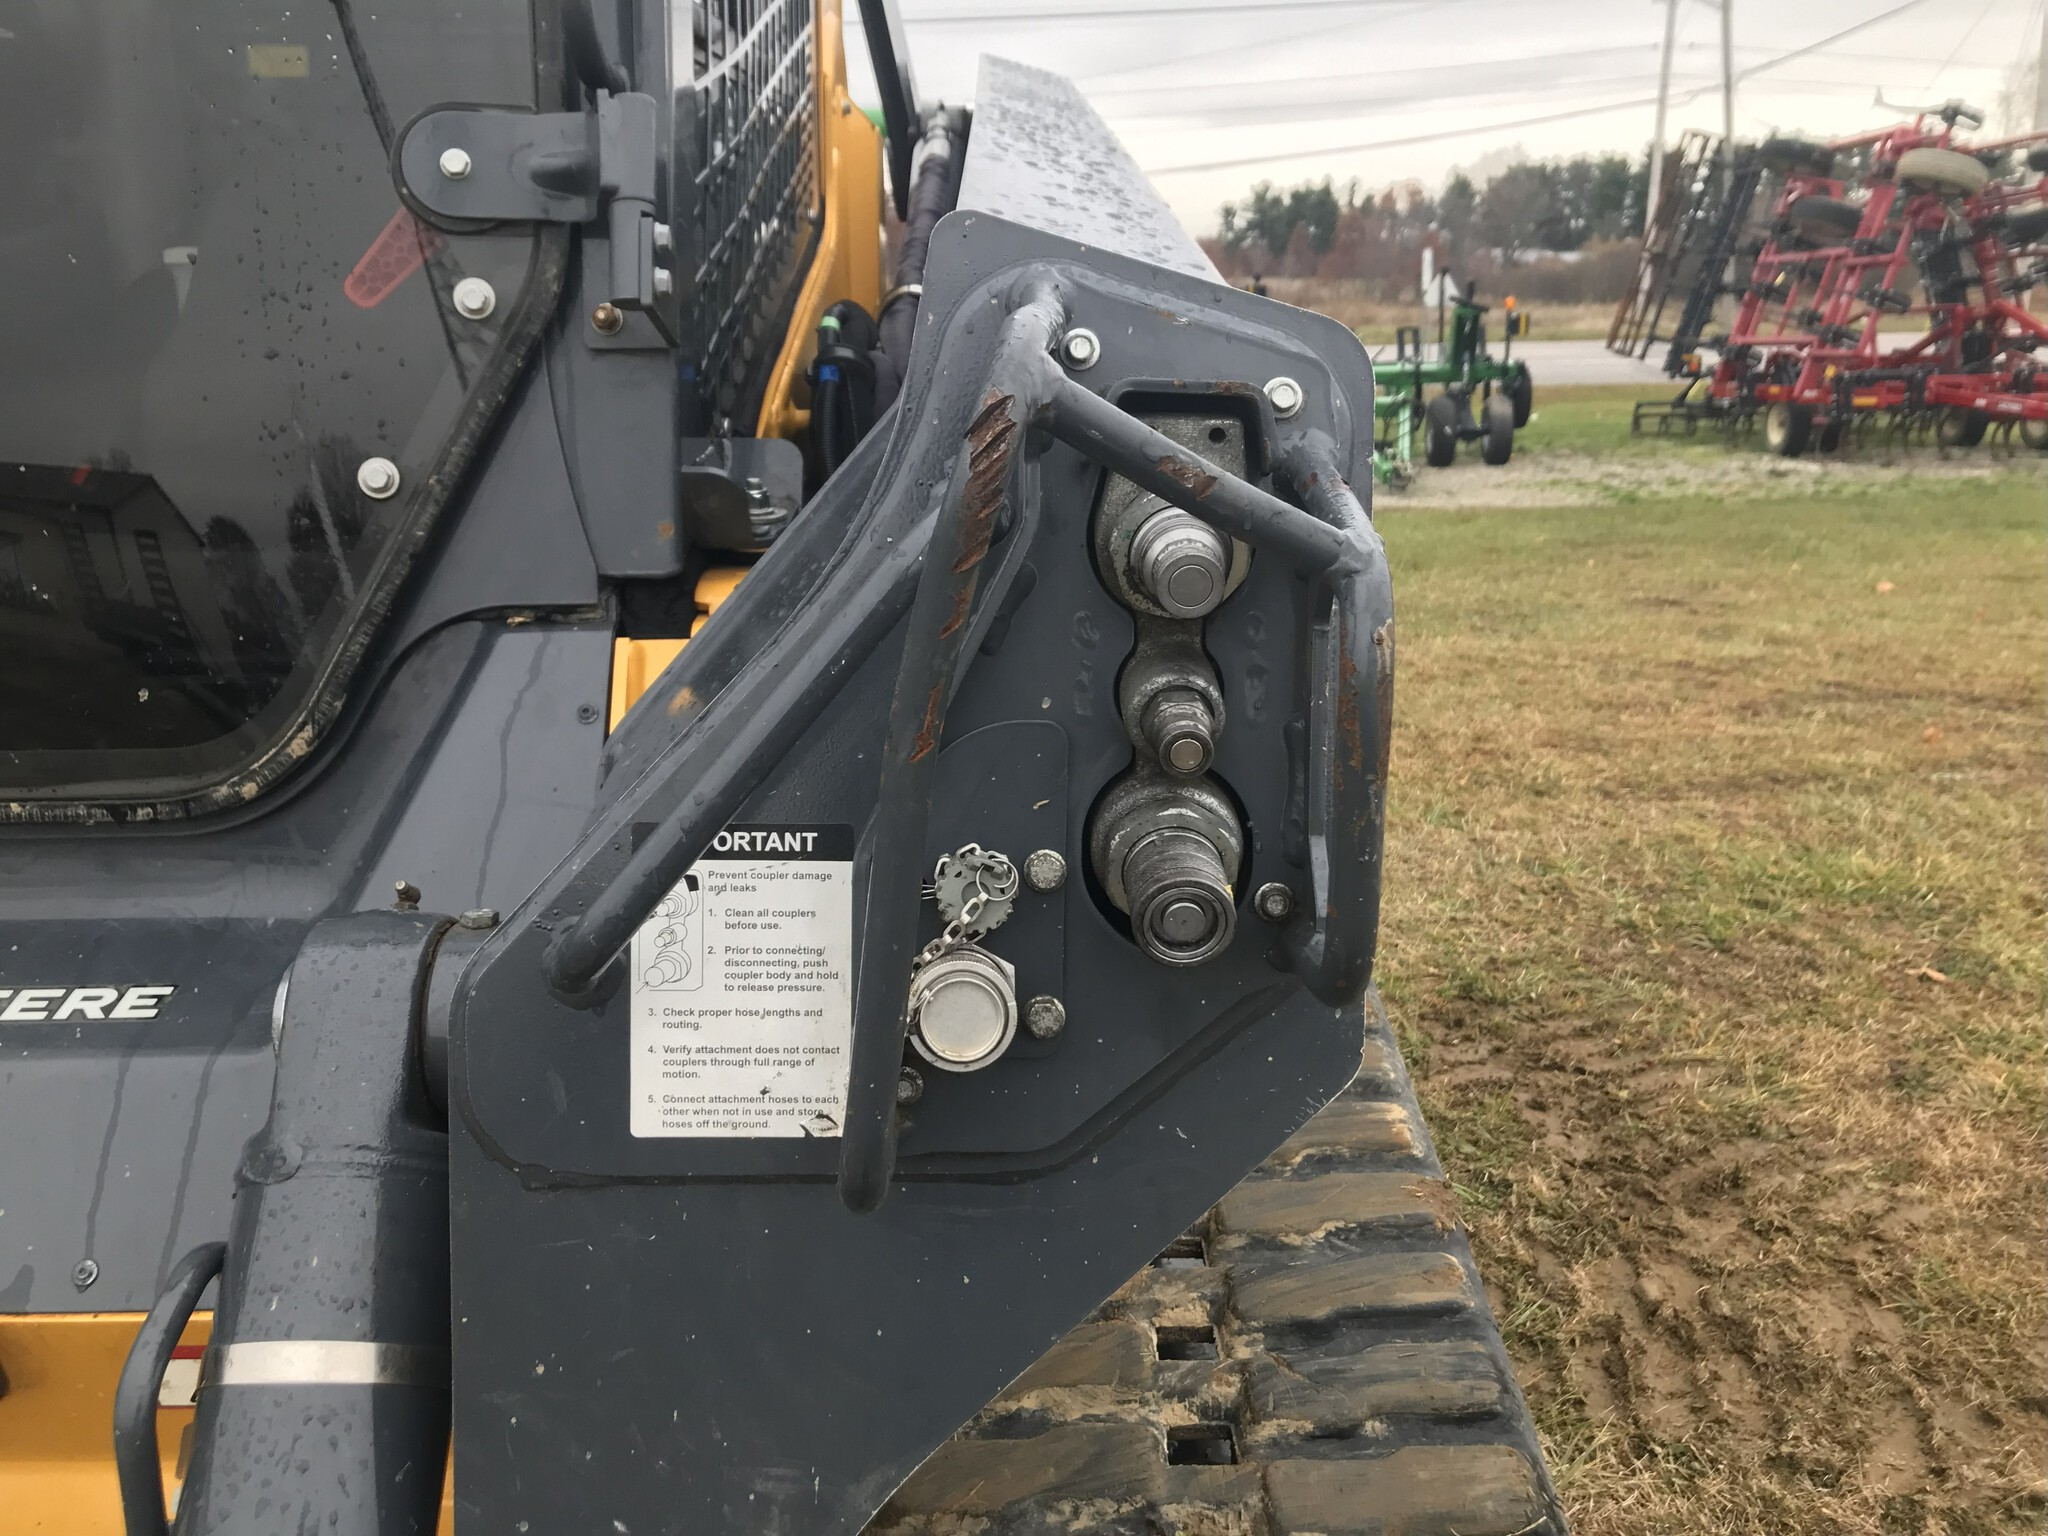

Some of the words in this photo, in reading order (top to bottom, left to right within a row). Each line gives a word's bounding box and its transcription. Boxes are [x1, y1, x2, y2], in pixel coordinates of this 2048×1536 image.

[712, 831, 819, 852] ORTANT
[708, 870, 748, 880] Prevent
[750, 871, 790, 883] coupler
[792, 872, 833, 884] damage
[707, 883, 727, 892] and
[730, 883, 757, 892] leaks
[708, 908, 717, 917] 1.
[724, 908, 754, 918] Clean
[757, 908, 769, 918] all
[771, 908, 816, 921] couplers
[724, 921, 758, 930] before
[760, 922, 782, 930] use.
[707, 946, 717, 955] 2.
[724, 945, 749, 955] Prior
[752, 946, 763, 955] to
[765, 945, 826, 958] connecting/
[724, 958, 800, 971] disconnecting,
[802, 959, 829, 971] push
[724, 970, 763, 983] coupler
[766, 971, 792, 983] body
[794, 971, 813, 980] and
[816, 971, 839, 980] hold
[724, 983, 735, 993] to
[737, 983, 775, 993] release
[777, 984, 826, 995] pressure.
[0, 987, 174, 1020] ERE
[647, 1008, 657, 1017] 3.
[662, 1008, 695, 1017] Check
[698, 1009, 731, 1020] proper
[735, 1008, 760, 1017] hose
[763, 1008, 801, 1020] lengths
[803, 1008, 823, 1017] and
[662, 1020, 702, 1030] routing.
[647, 1046, 656, 1054] 4.
[662, 1045, 692, 1056] Verify
[695, 1046, 753, 1055] attachment
[755, 1046, 780, 1055] does
[782, 1046, 800, 1055] not
[802, 1046, 840, 1055] contact
[662, 1057, 707, 1069] couplers
[710, 1058, 751, 1069] through
[753, 1058, 770, 1067] full
[772, 1059, 802, 1069] range
[804, 1058, 816, 1067] of
[662, 1070, 701, 1079] motion.
[647, 1095, 656, 1104] 5.
[662, 1095, 706, 1104] Connect
[708, 1095, 766, 1104] attachment
[768, 1095, 799, 1104] hoses
[802, 1096, 813, 1104] to
[814, 1095, 839, 1105] each
[662, 1107, 689, 1116] other
[692, 1107, 720, 1116] when
[722, 1108, 739, 1116] not
[742, 1107, 751, 1116] in
[754, 1108, 773, 1116] use
[775, 1107, 795, 1116] and
[797, 1108, 824, 1117] store
[662, 1120, 693, 1129] hoses
[695, 1119, 710, 1129] off
[712, 1120, 728, 1129] the
[731, 1120, 771, 1131] ground.
